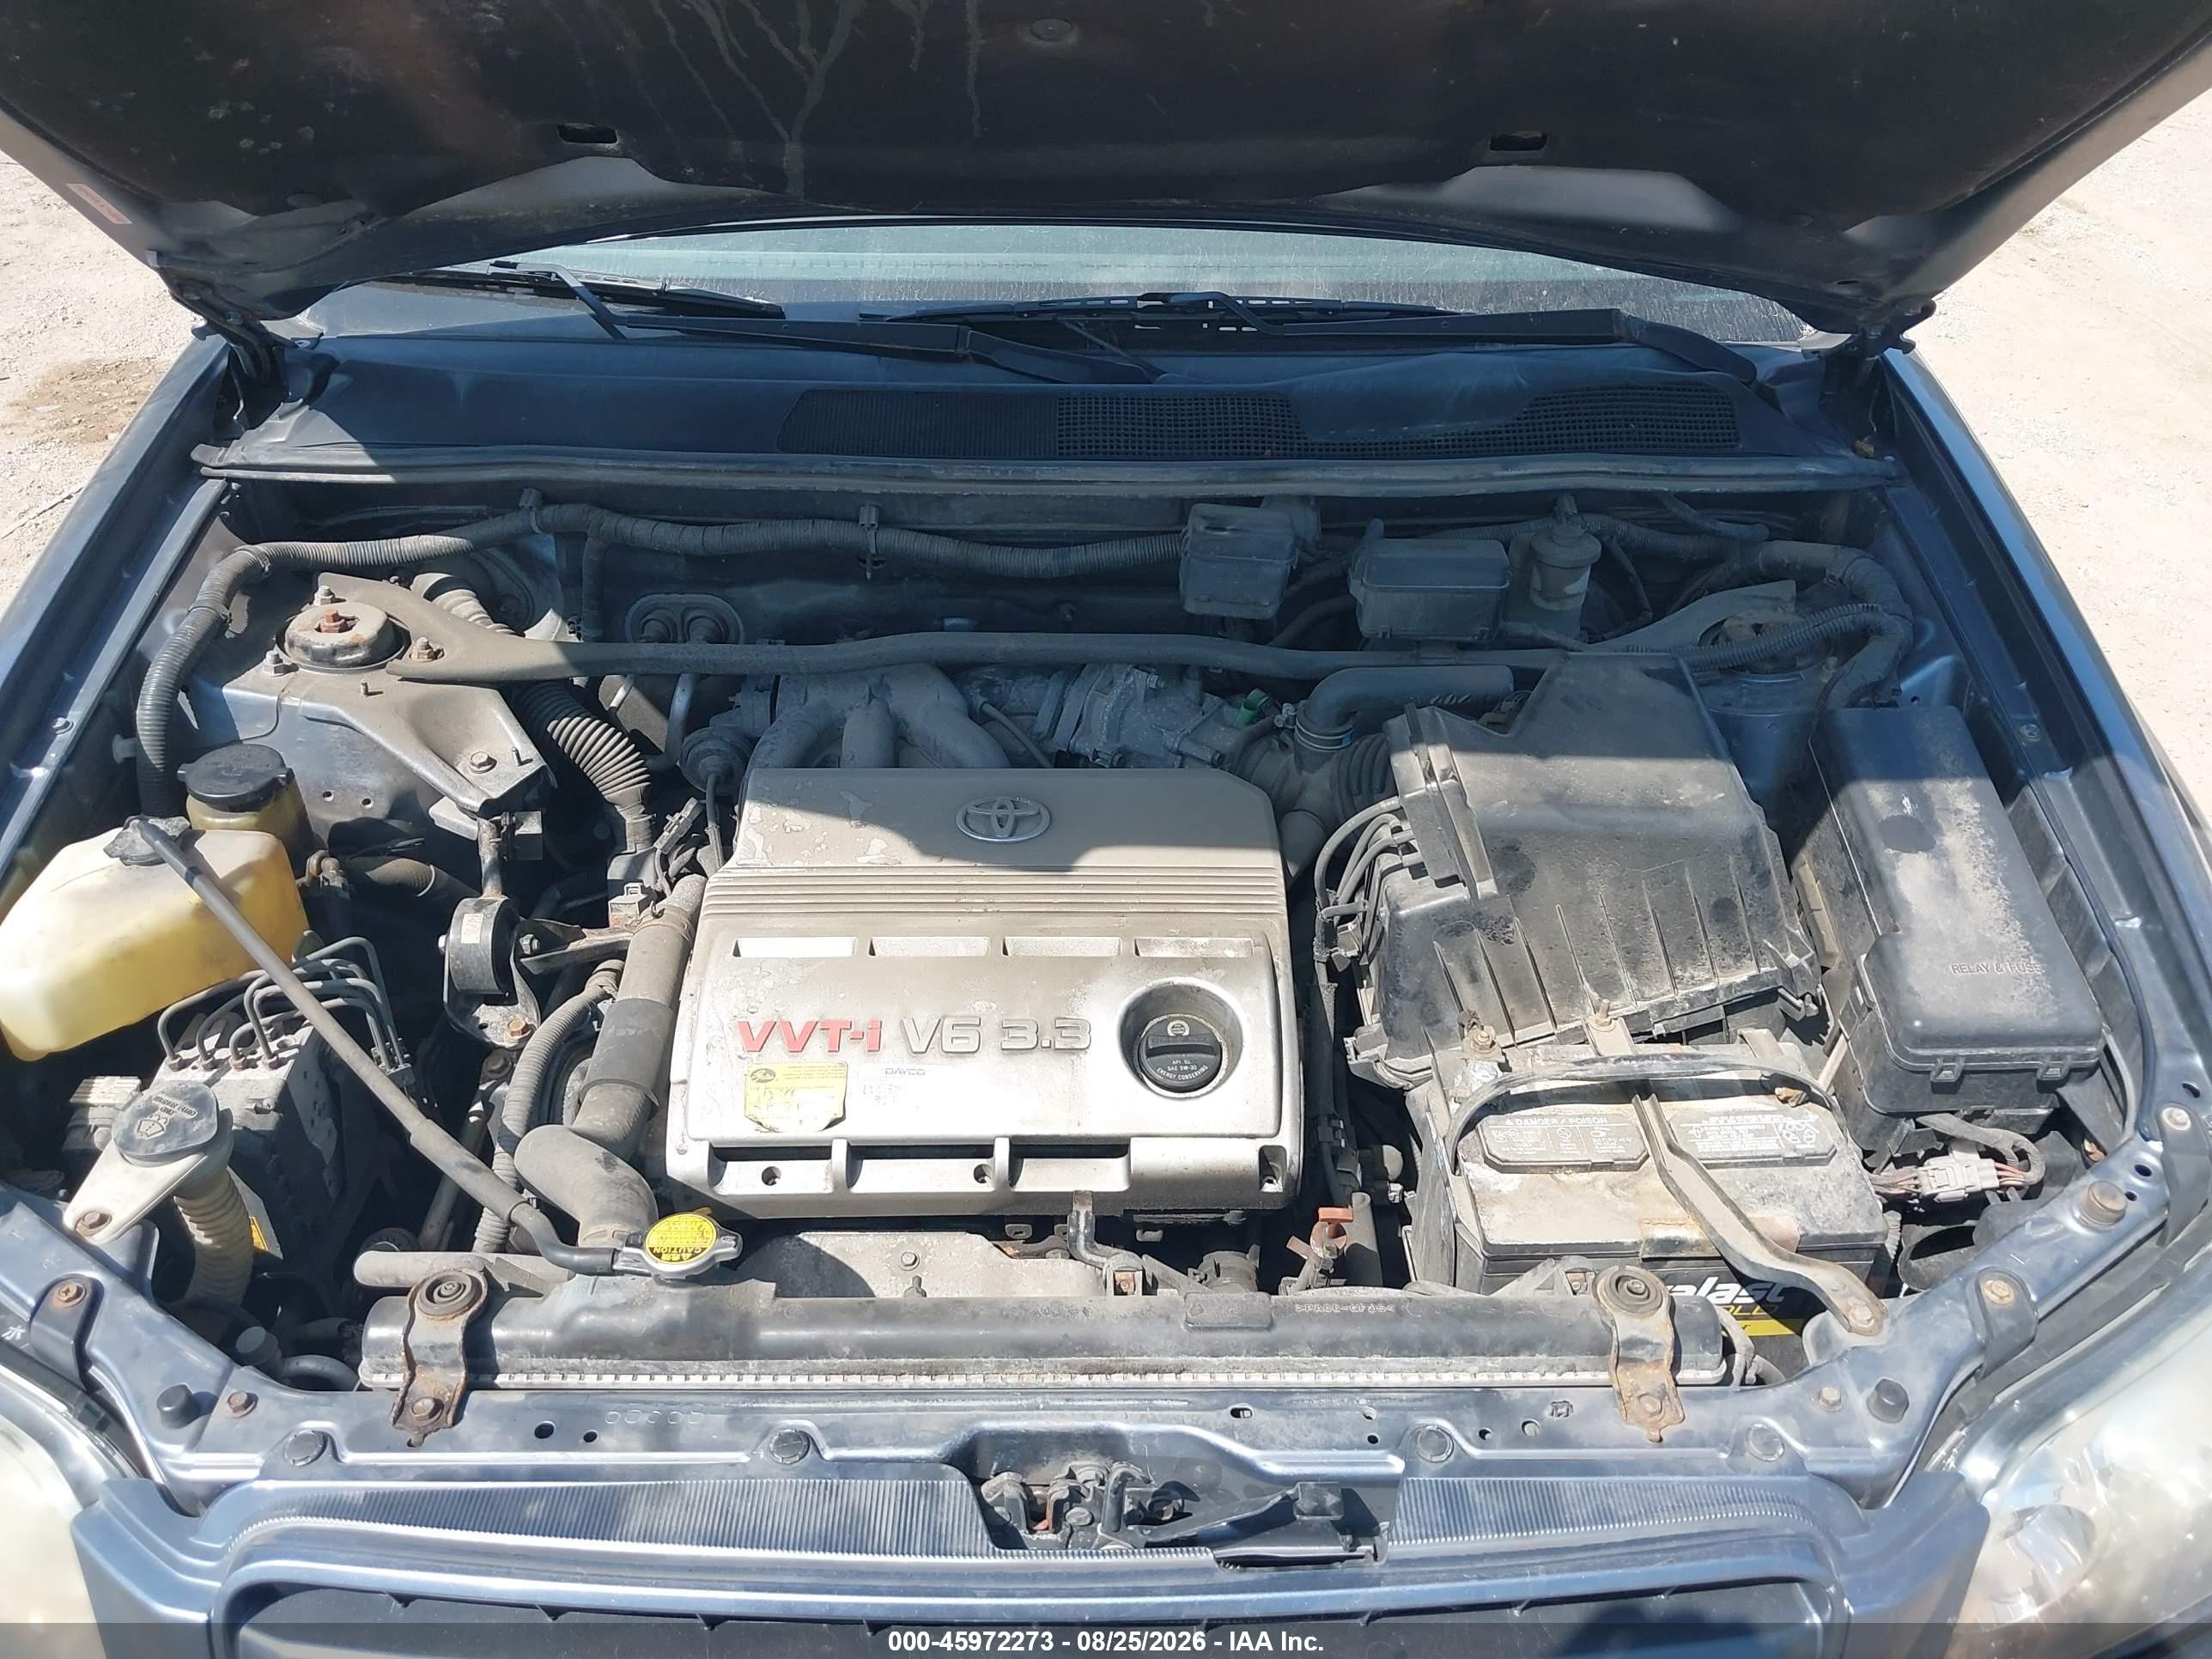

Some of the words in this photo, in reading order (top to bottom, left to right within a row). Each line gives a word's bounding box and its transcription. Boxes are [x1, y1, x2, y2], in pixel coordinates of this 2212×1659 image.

[1951, 963, 1990, 974] RELAY
[1995, 963, 2004, 974] &
[2009, 963, 2041, 973] FUSE
[737, 1019, 883, 1053] VVT-i
[901, 1017, 981, 1054] V6
[1000, 1018, 1091, 1050] 3.3
[1157, 1066, 1176, 1079] ENERGY
[1177, 1065, 1208, 1080] CONSERVING
